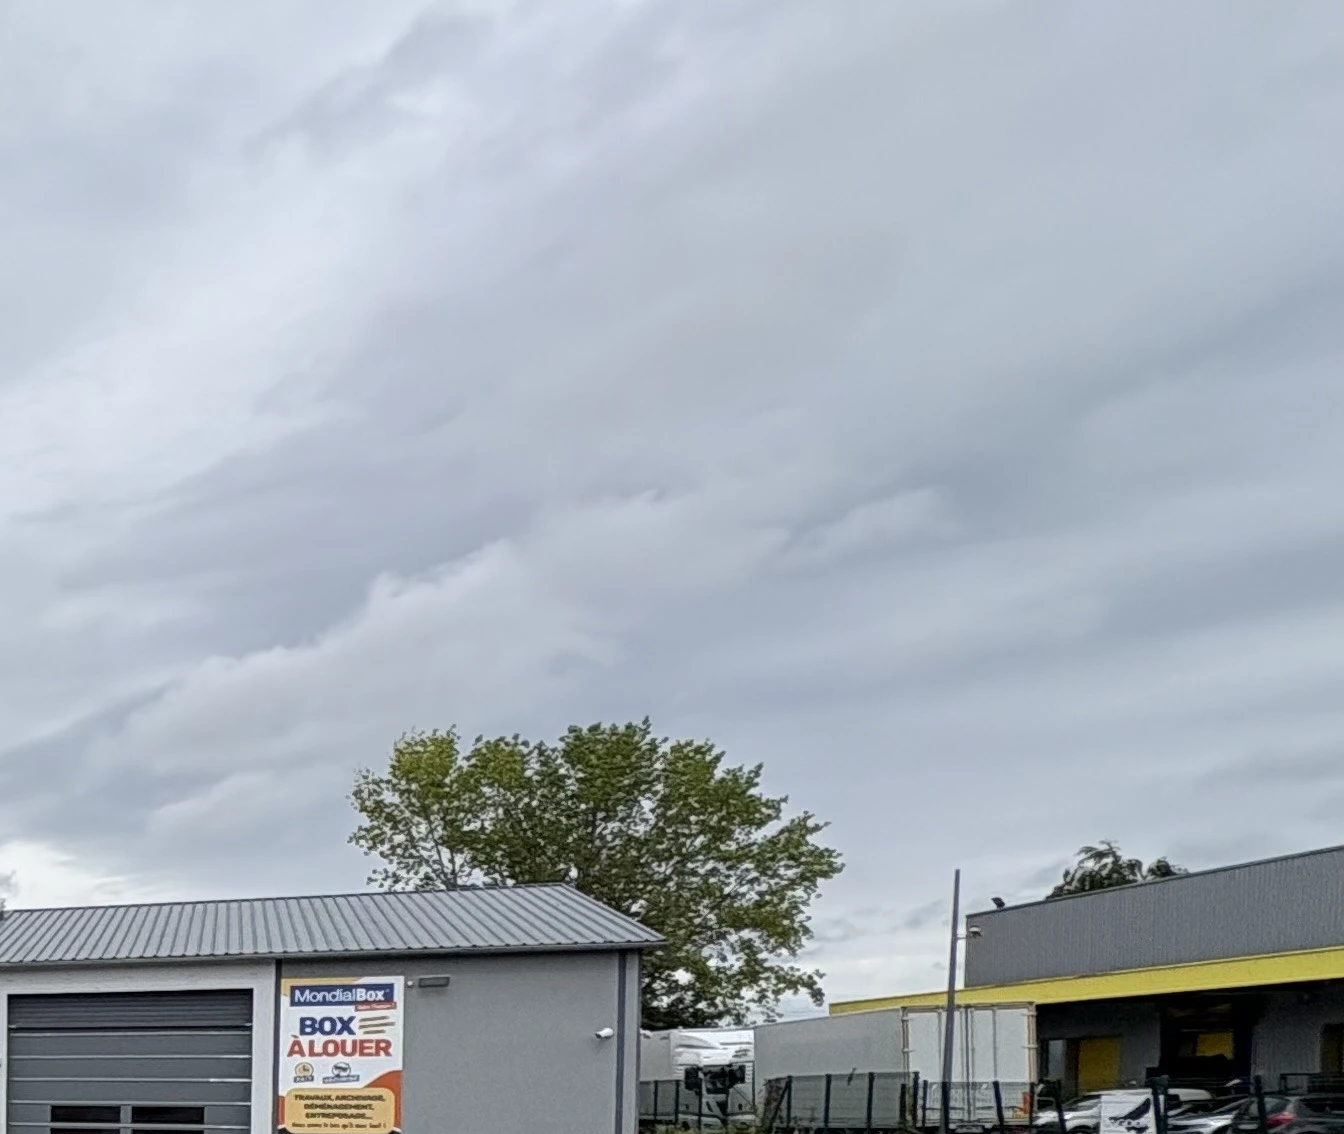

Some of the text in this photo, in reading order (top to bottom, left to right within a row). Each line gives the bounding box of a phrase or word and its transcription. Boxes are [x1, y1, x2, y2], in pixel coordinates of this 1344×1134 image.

[294, 988, 385, 1003] MondialBox
[299, 1016, 356, 1036] BOX
[286, 1034, 392, 1057] À LOUER
